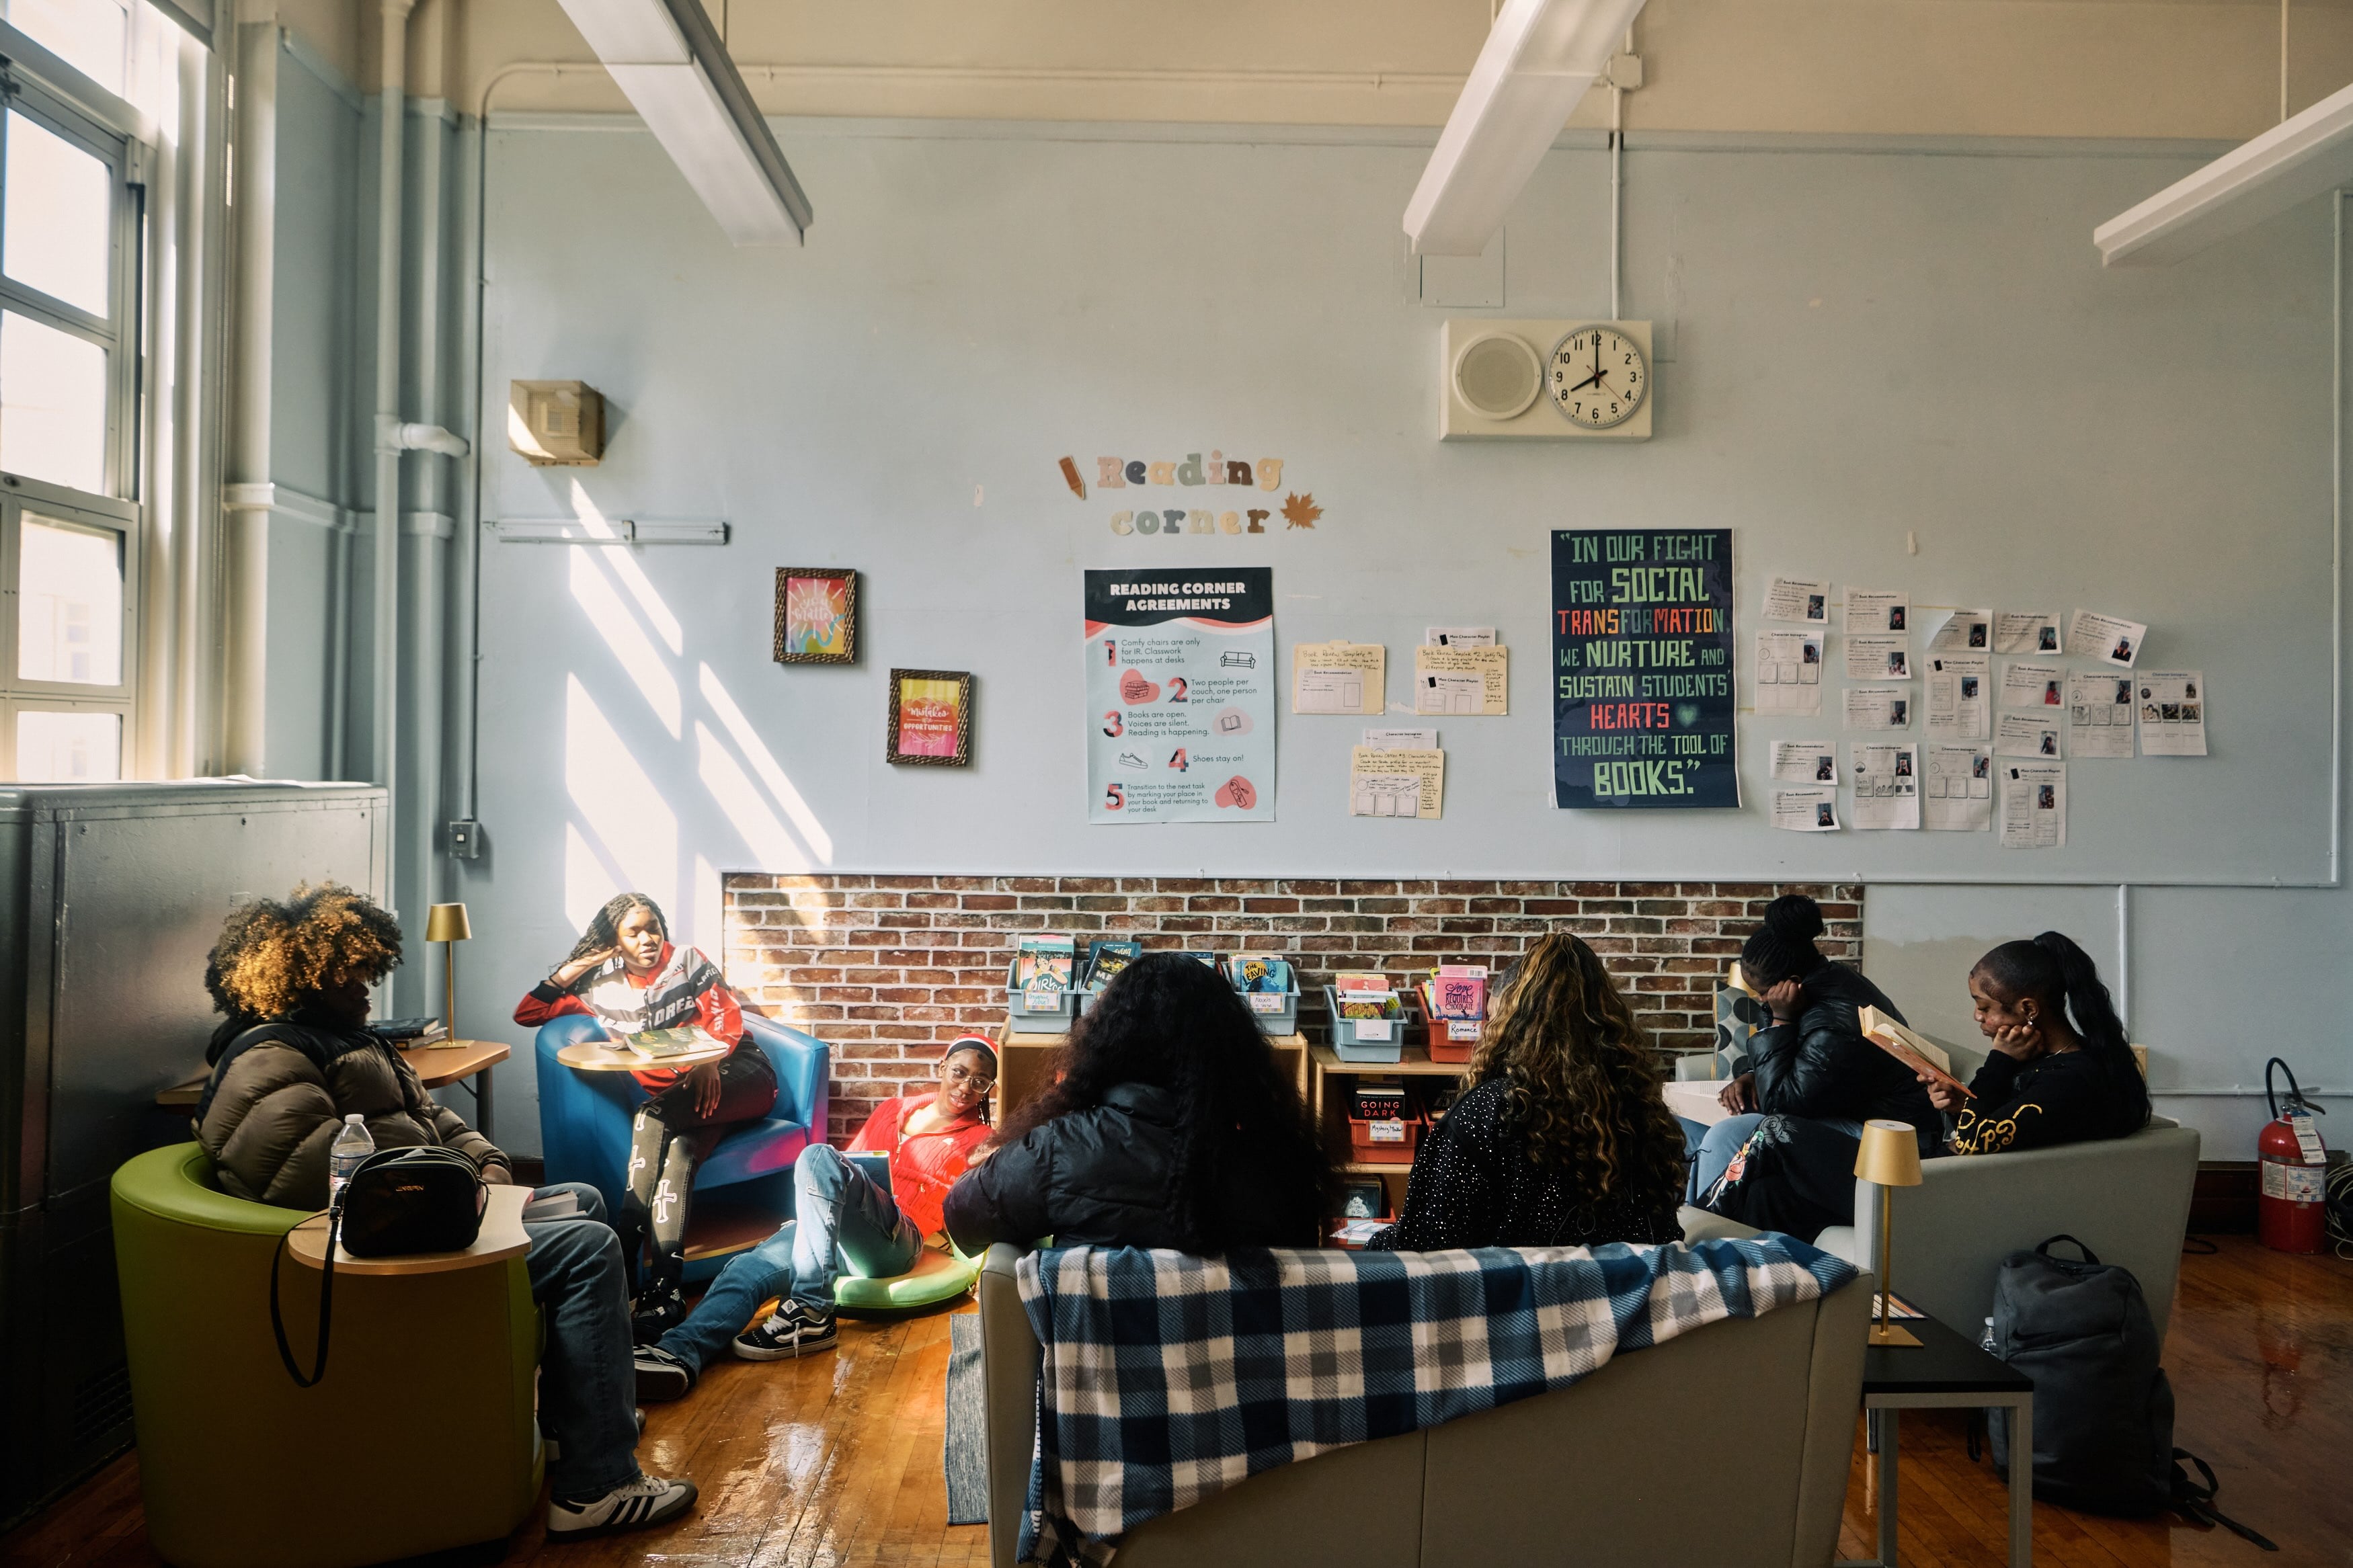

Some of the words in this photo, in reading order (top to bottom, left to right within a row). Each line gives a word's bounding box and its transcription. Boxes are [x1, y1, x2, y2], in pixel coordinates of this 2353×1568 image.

[1574, 339, 1583, 351] 11
[1591, 334, 1601, 345] 12
[1612, 340, 1616, 351] 1
[1560, 352, 1570, 364] 10
[1625, 354, 1632, 364] 2
[1556, 372, 1562, 382] 9
[1630, 372, 1636, 382] 3
[1561, 390, 1568, 401] 8
[1624, 390, 1631, 401] 4
[1574, 403, 1581, 414] 7
[1611, 403, 1618, 413] 5
[1592, 409, 1599, 419] 6
[1096, 449, 1284, 492] Reading
[1110, 508, 1271, 536] corner
[1605, 535, 1644, 561] OUR
[1654, 534, 1717, 561] FIGHT
[1111, 583, 1179, 595] READING
[1182, 582, 1246, 594] CORNER
[1570, 580, 1604, 604] FOR
[1612, 567, 1710, 603] SOCIAL
[1125, 598, 1231, 612] AGREEMENTS
[1558, 608, 1730, 636] TRANSFORMATION,
[1121, 640, 1144, 649] Comfy
[1186, 637, 1201, 649] only
[1105, 640, 1116, 667] 1
[1560, 648, 1580, 667] WE
[1586, 640, 1695, 668] NURTURE
[1701, 649, 1724, 665] AND
[1121, 657, 1154, 665] happens
[1166, 655, 1185, 664] desks
[1191, 679, 1206, 687] Two
[1208, 677, 1234, 689] people
[1236, 679, 1249, 688] per
[1560, 675, 1634, 699] SUSTAIN
[1167, 677, 1187, 703] 2
[1191, 687, 1215, 696] couch,
[1233, 688, 1257, 696] person
[1191, 698, 1204, 706] per
[1128, 710, 1150, 718] Books
[1166, 712, 1187, 720] open.
[1591, 702, 1669, 729] HEARTS
[904, 723, 952, 731] OPPORTUNITIES
[1103, 710, 1123, 738] 3
[1168, 719, 1189, 727] silent.
[1128, 729, 1159, 738] Reading
[1168, 729, 1210, 738] happening.
[1560, 736, 1635, 755] THROUGH
[1638, 735, 1667, 755] THE
[1671, 735, 1706, 755] TOOL
[1710, 734, 1728, 754] OF
[1168, 747, 1189, 772] 4
[1215, 755, 1230, 764] stay
[1105, 784, 1125, 811] 5
[1139, 790, 1162, 798] marking
[1245, 962, 1257, 971] THE
[1242, 968, 1276, 986] LEAVING
[1445, 983, 1474, 995] Love
[1445, 993, 1474, 1003] REQUIRES
[1341, 1003, 1384, 1016] SNAPDRAGON
[1451, 1024, 1478, 1035] Romance
[1361, 1101, 1400, 1109] GOING
[1371, 1124, 1389, 1134] Mystery
